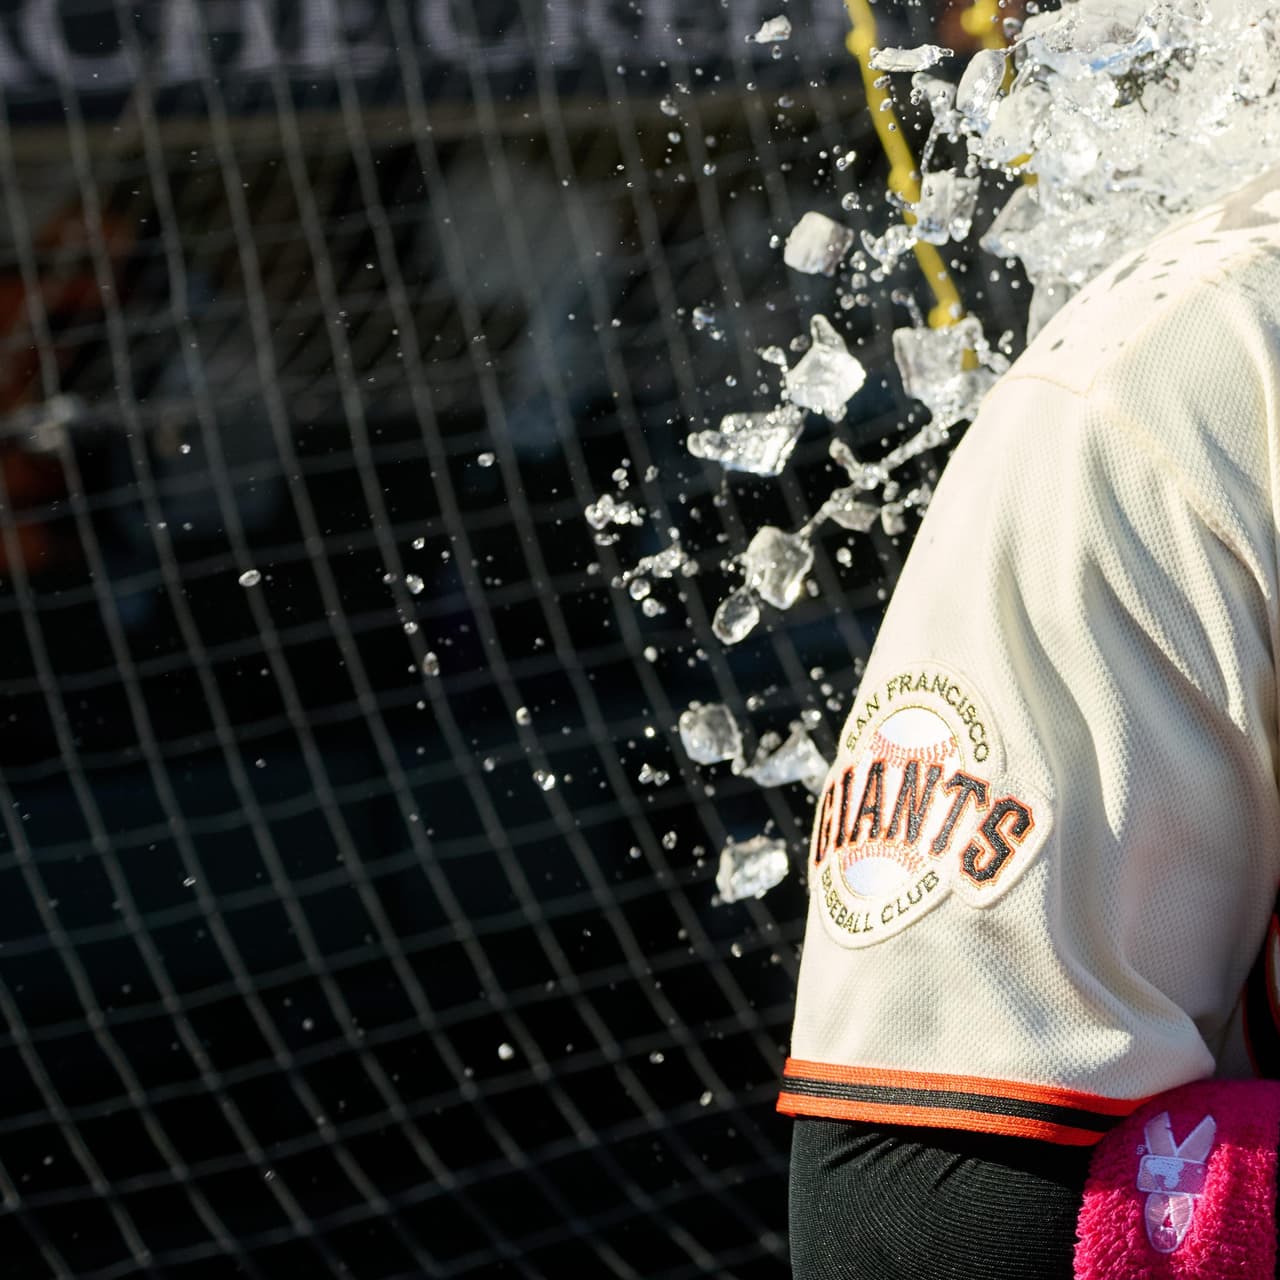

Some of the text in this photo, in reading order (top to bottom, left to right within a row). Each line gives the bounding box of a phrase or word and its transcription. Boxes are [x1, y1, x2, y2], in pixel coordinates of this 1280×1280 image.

[845, 672, 990, 763] SAN FRANCISCO
[815, 758, 1035, 889] GIANTS
[821, 869, 940, 934] BASEBALL CLUB
